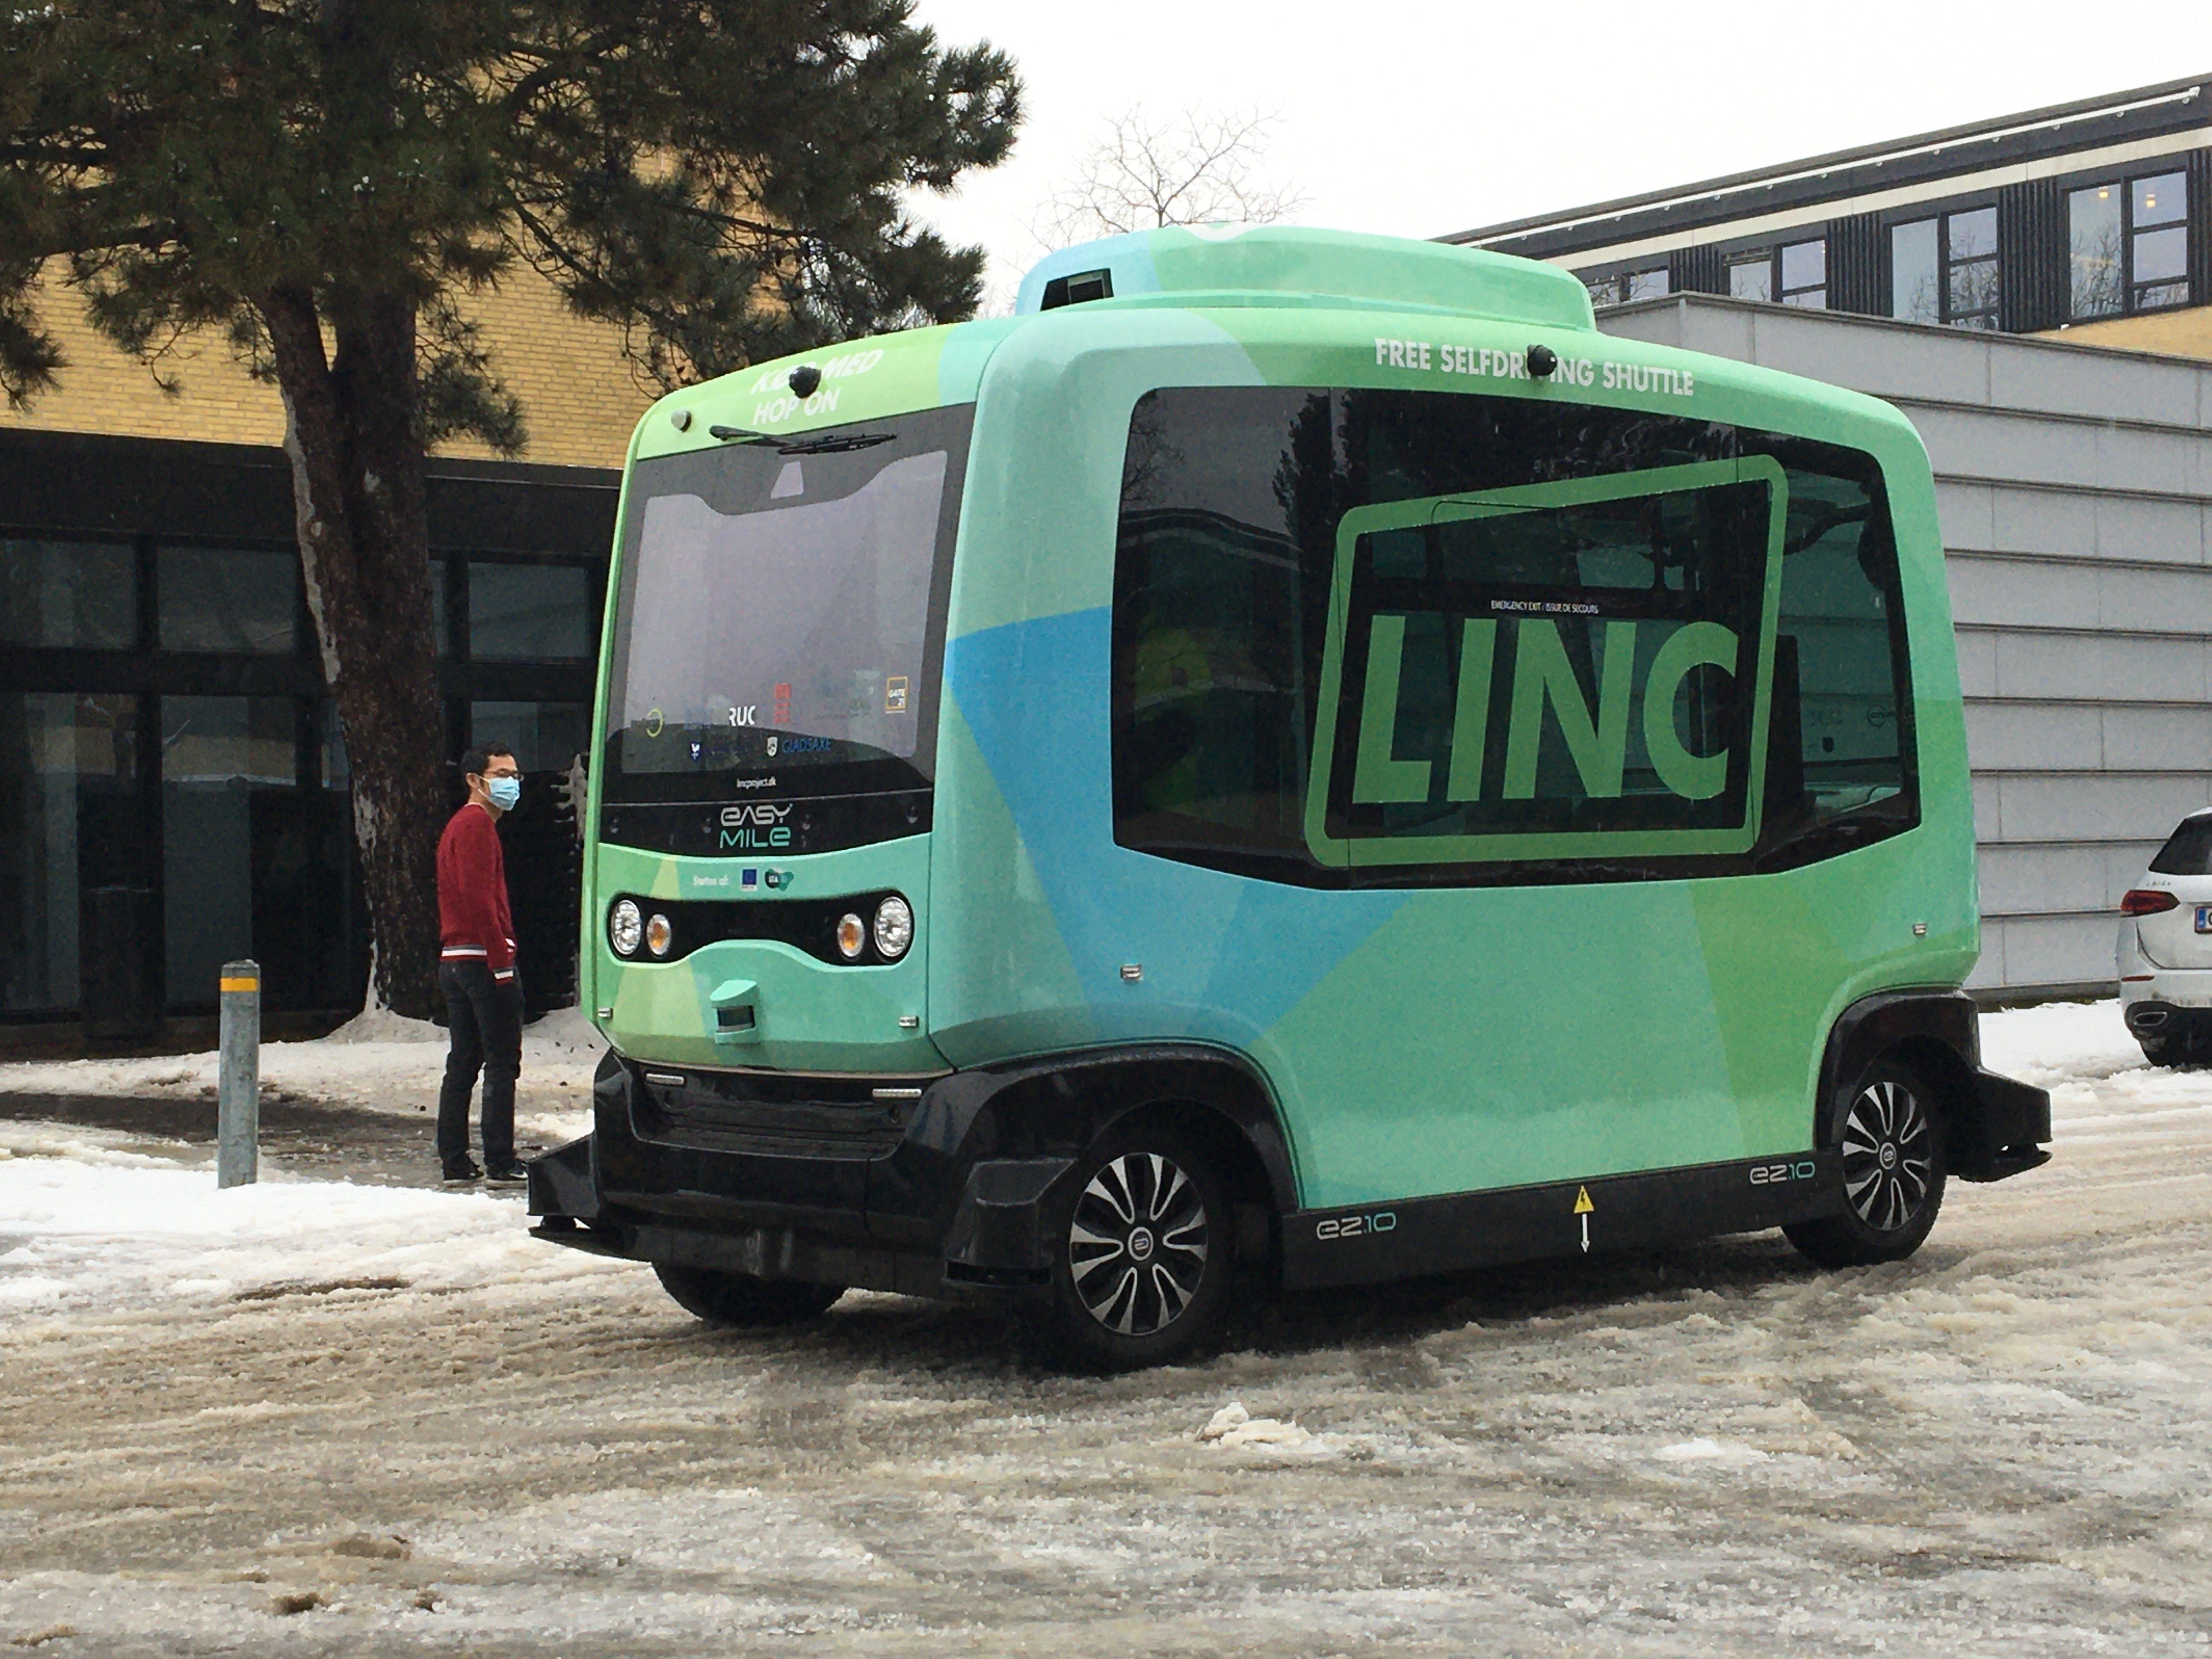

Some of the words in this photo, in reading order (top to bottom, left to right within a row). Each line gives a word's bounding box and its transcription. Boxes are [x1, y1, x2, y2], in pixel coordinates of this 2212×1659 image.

[749, 361, 816, 394] KØ
[822, 349, 884, 380] MED
[1374, 338, 1431, 370] FREE
[1440, 344, 1594, 386] SELFDRING
[1602, 361, 1694, 396] SHUTTLE
[752, 396, 800, 425] HOP
[804, 388, 841, 416] ON
[729, 705, 756, 727] RUC
[1352, 614, 1739, 804] LINC
